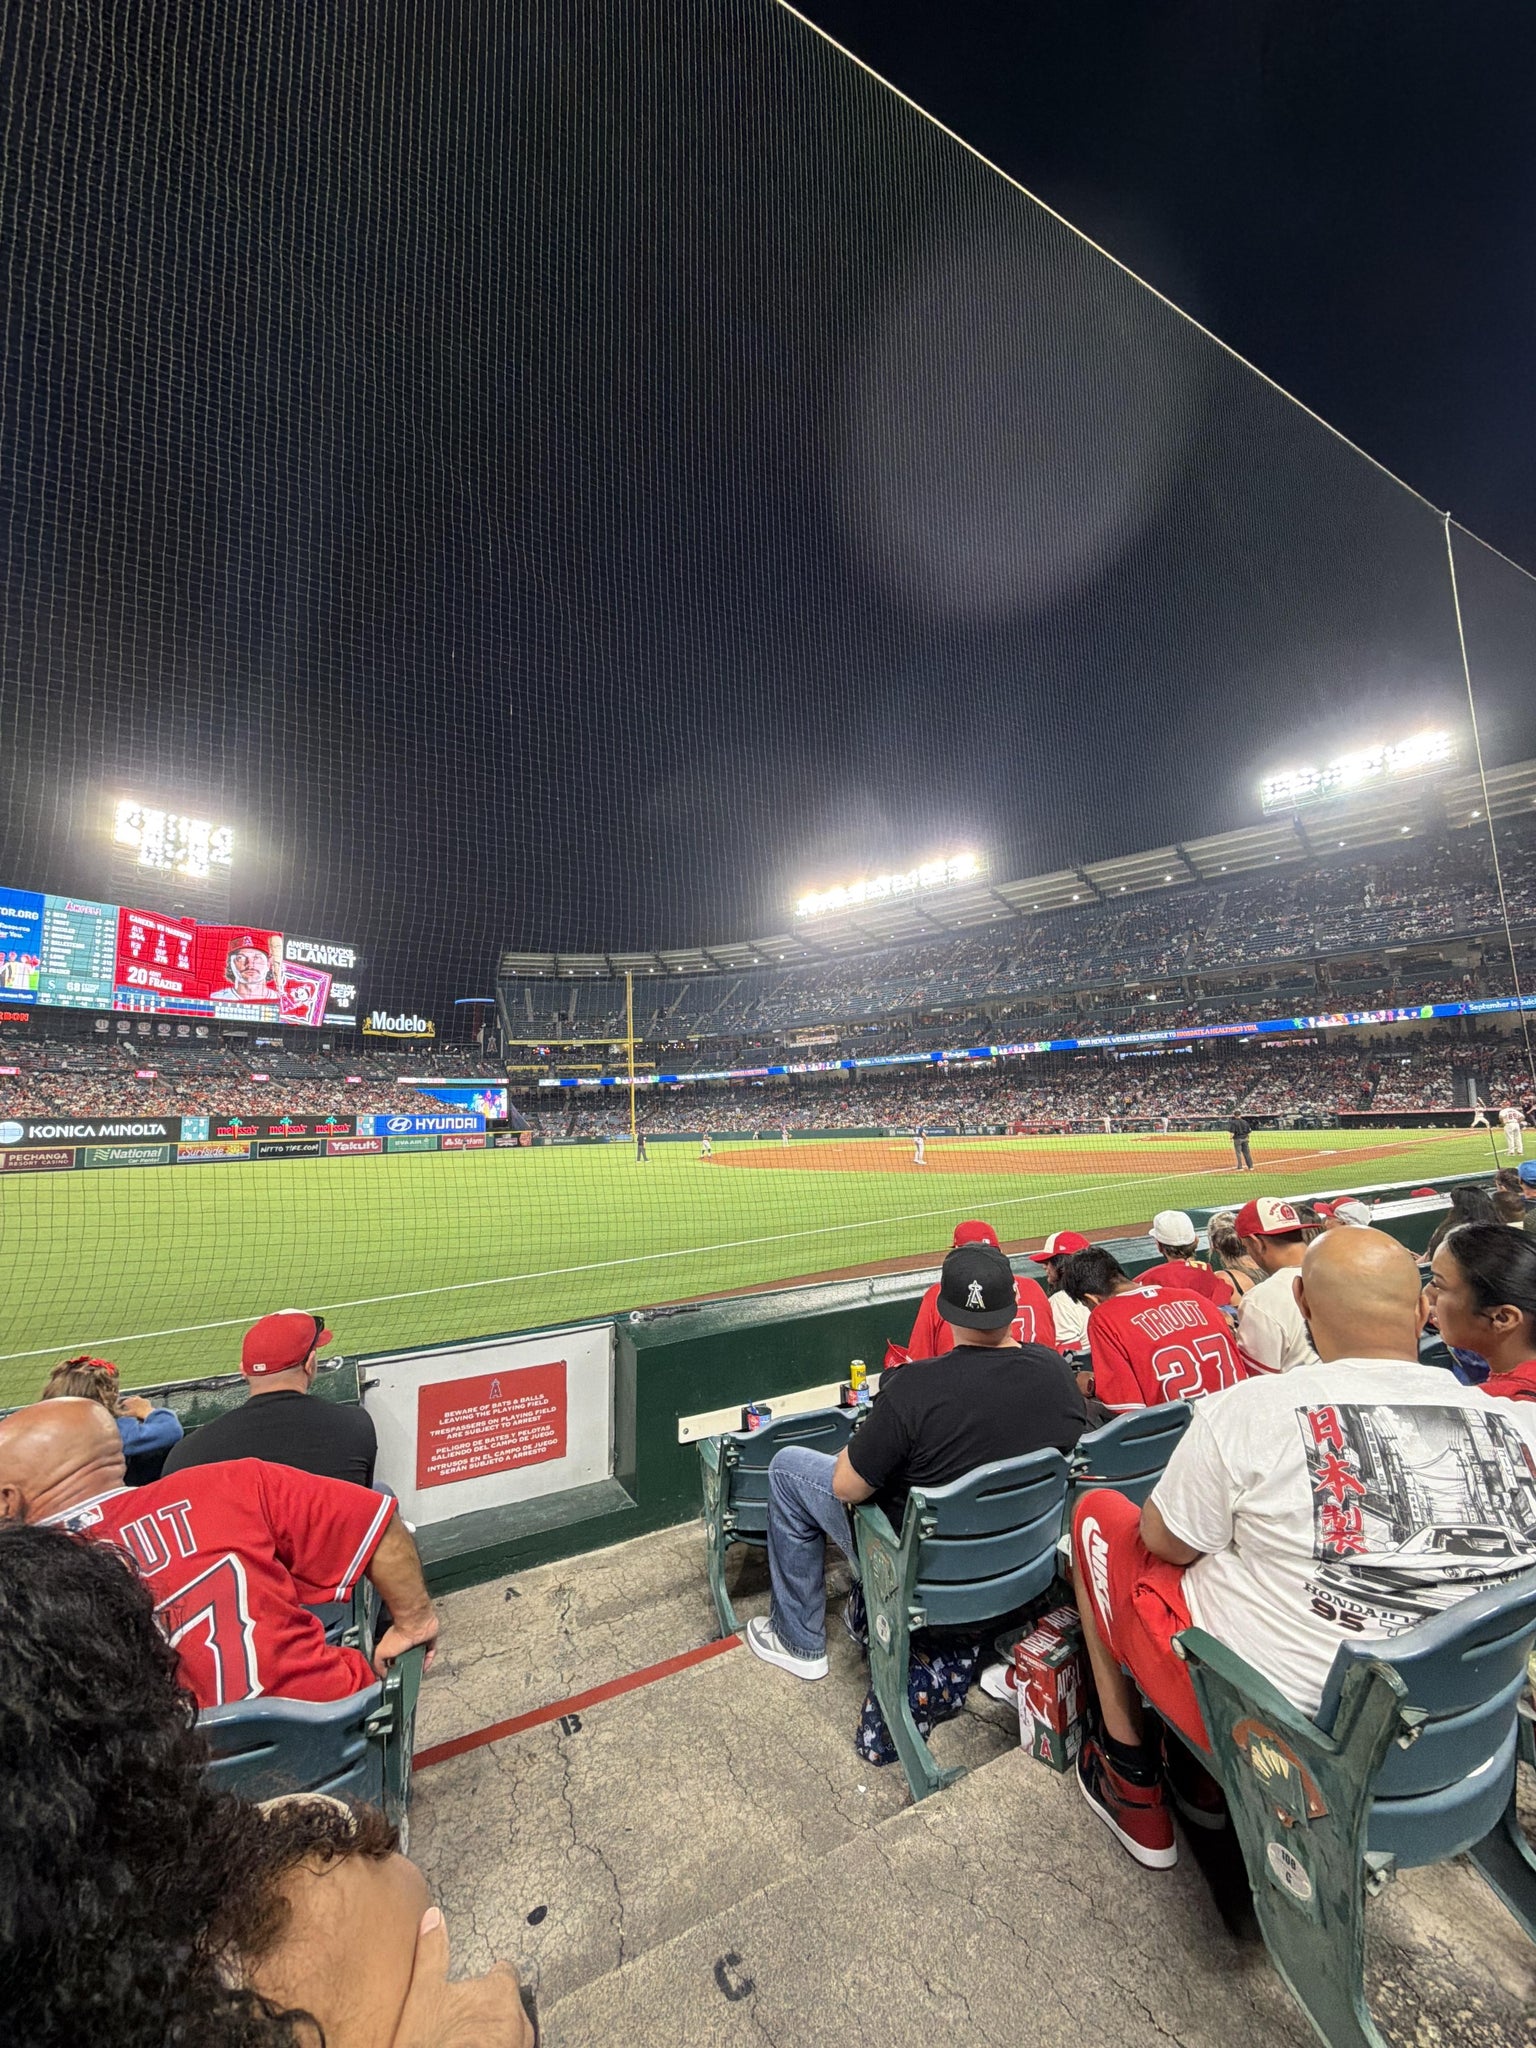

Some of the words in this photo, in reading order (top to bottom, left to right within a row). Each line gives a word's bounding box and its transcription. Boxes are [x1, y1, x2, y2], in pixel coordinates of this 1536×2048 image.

[286, 947, 357, 968] BLANKET
[287, 940, 319, 951] ANGELS
[327, 946, 355, 957] DUCKS
[128, 966, 148, 985] 20
[148, 976, 183, 991] FRAZIER
[330, 988, 357, 1001] SEPT
[1469, 1001, 1510, 1011] September
[1511, 999, 1518, 1007] is
[371, 1011, 427, 1032] Modelo
[1112, 1035, 1140, 1043] WELLNESS
[1140, 1033, 1169, 1041] RESOURCE
[29, 1125, 96, 1138] KONICA
[99, 1124, 167, 1136] MINOLTA
[415, 1118, 477, 1130] HYUNDAI
[9, 1152, 69, 1161] PECHANGA
[109, 1148, 162, 1159] National
[182, 1145, 225, 1158] Surfside
[260, 1145, 284, 1153] NITTO
[331, 1141, 380, 1151] Yakult
[1131, 1300, 1208, 1341] TROUT
[1152, 1333, 1239, 1402] 27
[439, 1414, 474, 1425] LEAVING
[492, 1404, 526, 1415] PLAYING
[527, 1399, 549, 1408] FIELD
[444, 1407, 478, 1418] BEWARE
[479, 1404, 490, 1412] OF
[491, 1400, 512, 1409] BATS
[520, 1394, 544, 1404] BALLS
[430, 1420, 487, 1437] TRESPASSERS
[488, 1417, 499, 1425] ON
[500, 1412, 533, 1423] PLAYING
[535, 1406, 557, 1415] FIELD
[447, 1431, 463, 1440] ARE
[464, 1424, 499, 1436] SUBJECT
[512, 1415, 542, 1426] ARREST
[431, 1448, 472, 1462] SALIENDO
[474, 1444, 490, 1453] DEL
[491, 1438, 518, 1449] CAMPO
[530, 1430, 555, 1440] JUEGO
[436, 1442, 471, 1454] PELIGRO
[484, 1434, 509, 1444] BATES
[518, 1425, 551, 1437] PELOTAS
[427, 1459, 468, 1473] INTRUSOS
[494, 1447, 521, 1458] CAMPO
[534, 1438, 558, 1449] JUEGO
[440, 1464, 467, 1476] SERÁN
[469, 1457, 504, 1470] SUBJETO
[512, 1447, 547, 1459] ARRESTO
[1307, 1406, 1369, 1554] 日本製
[1090, 1533, 1114, 1622] NIKE
[1303, 1582, 1379, 1618] HONDA
[1309, 1598, 1367, 1632] 95
[558, 1713, 582, 1737] B
[1281, 1850, 1296, 1870] 108
